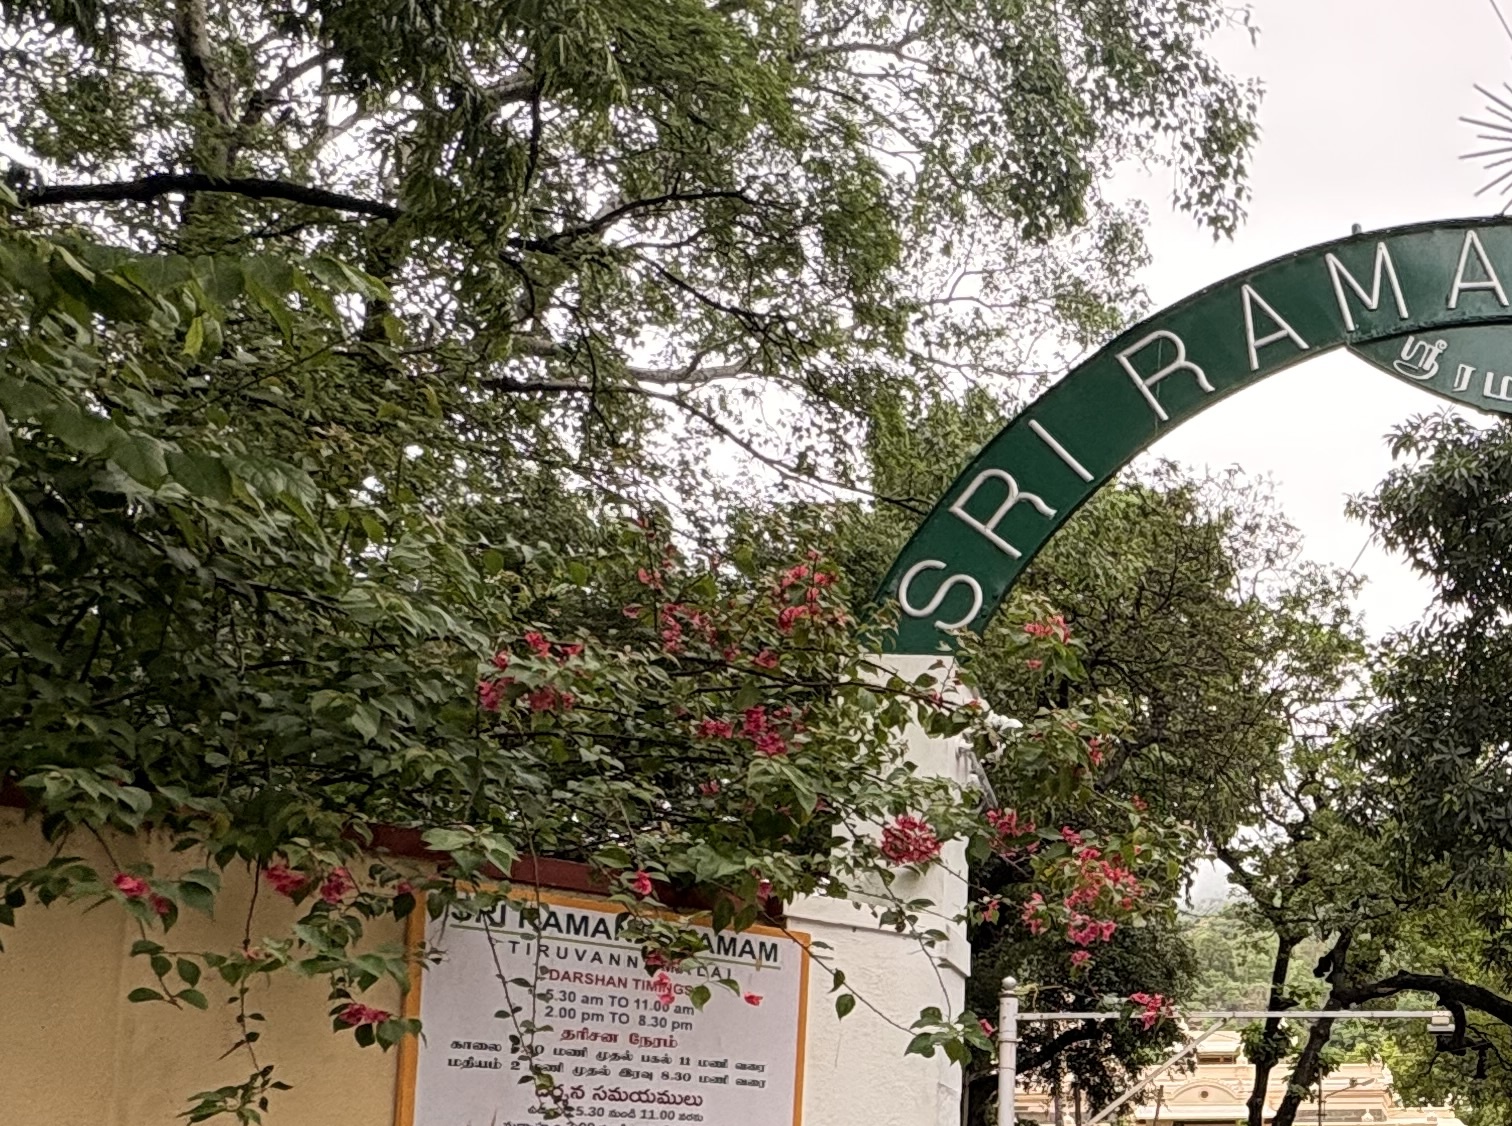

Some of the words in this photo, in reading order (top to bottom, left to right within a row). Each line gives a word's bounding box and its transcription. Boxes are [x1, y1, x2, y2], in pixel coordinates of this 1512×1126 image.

[898, 419, 1096, 632] SRI
[549, 968, 628, 989] DARSHAN
[545, 989, 576, 1003] 5.30
[580, 994, 604, 1006] am
[608, 995, 629, 1009] TO
[634, 998, 670, 1013] 11.00
[673, 1004, 695, 1016] am
[544, 1005, 576, 1019] 2.00
[581, 1010, 604, 1023] pm
[609, 1011, 630, 1025] TO
[638, 1015, 668, 1028] 8.30
[671, 1020, 693, 1032] pm
[510, 1060, 521, 1071] 2
[660, 1070, 692, 1082] 8.30
[679, 1056, 691, 1066] 11
[575, 1105, 605, 1118] 5.30
[640, 1109, 676, 1121] 11.00
